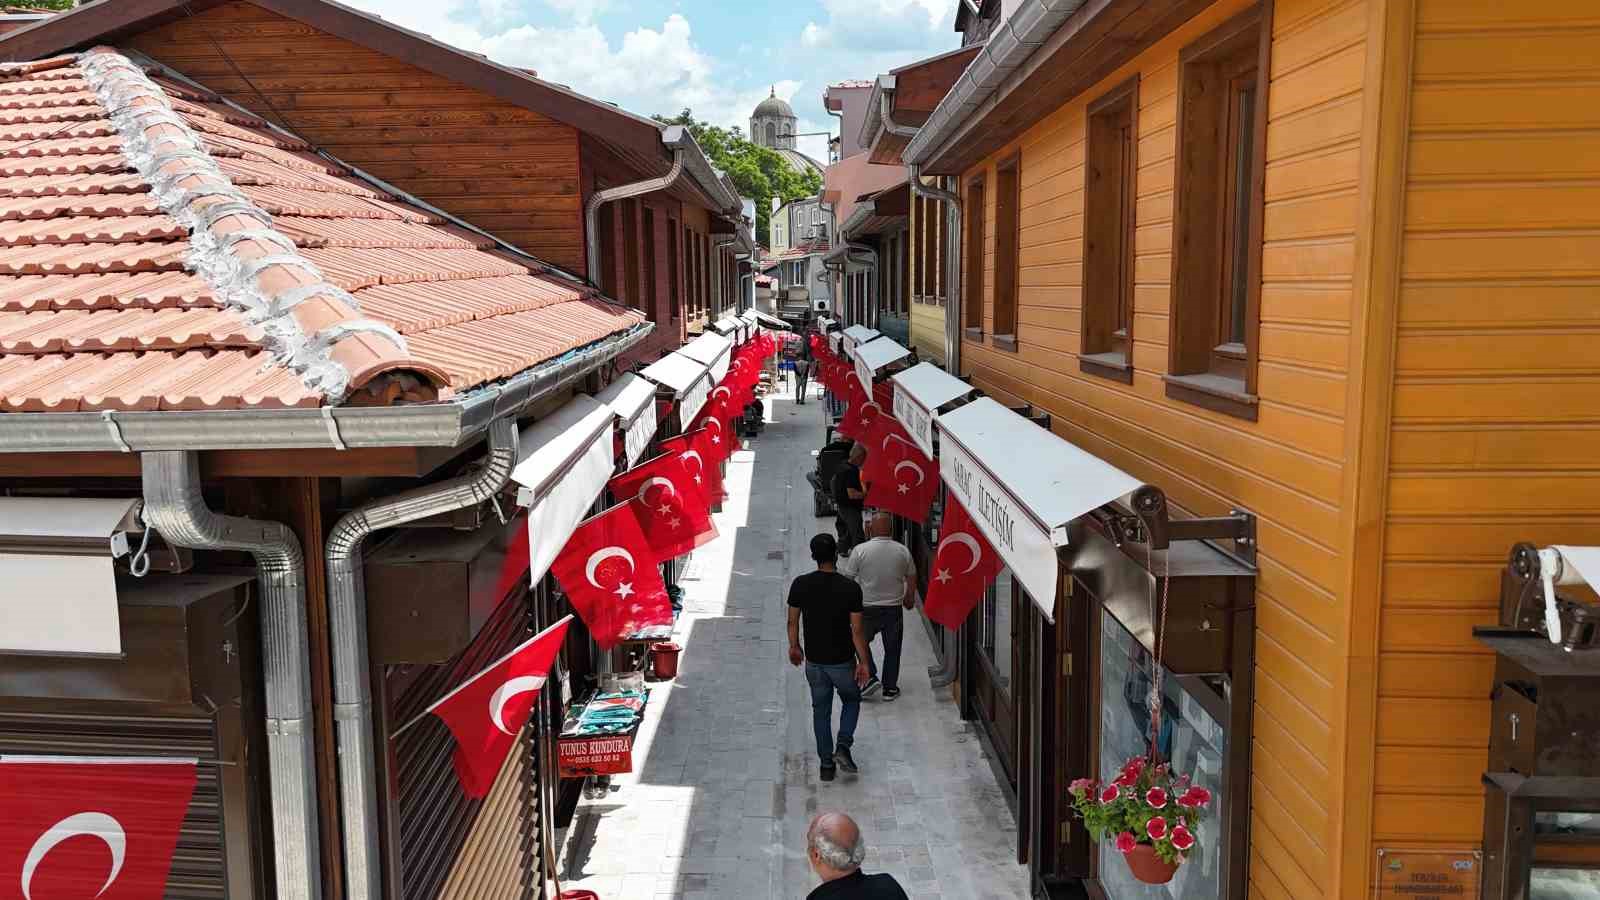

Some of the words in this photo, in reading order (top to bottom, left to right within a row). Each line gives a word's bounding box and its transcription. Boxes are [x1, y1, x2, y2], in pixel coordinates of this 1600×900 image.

[953, 456, 972, 507] SARAÇ
[978, 479, 1015, 552] İLETİŞİM
[559, 742, 588, 757] YUNUS
[588, 740, 630, 755] KUNDURA
